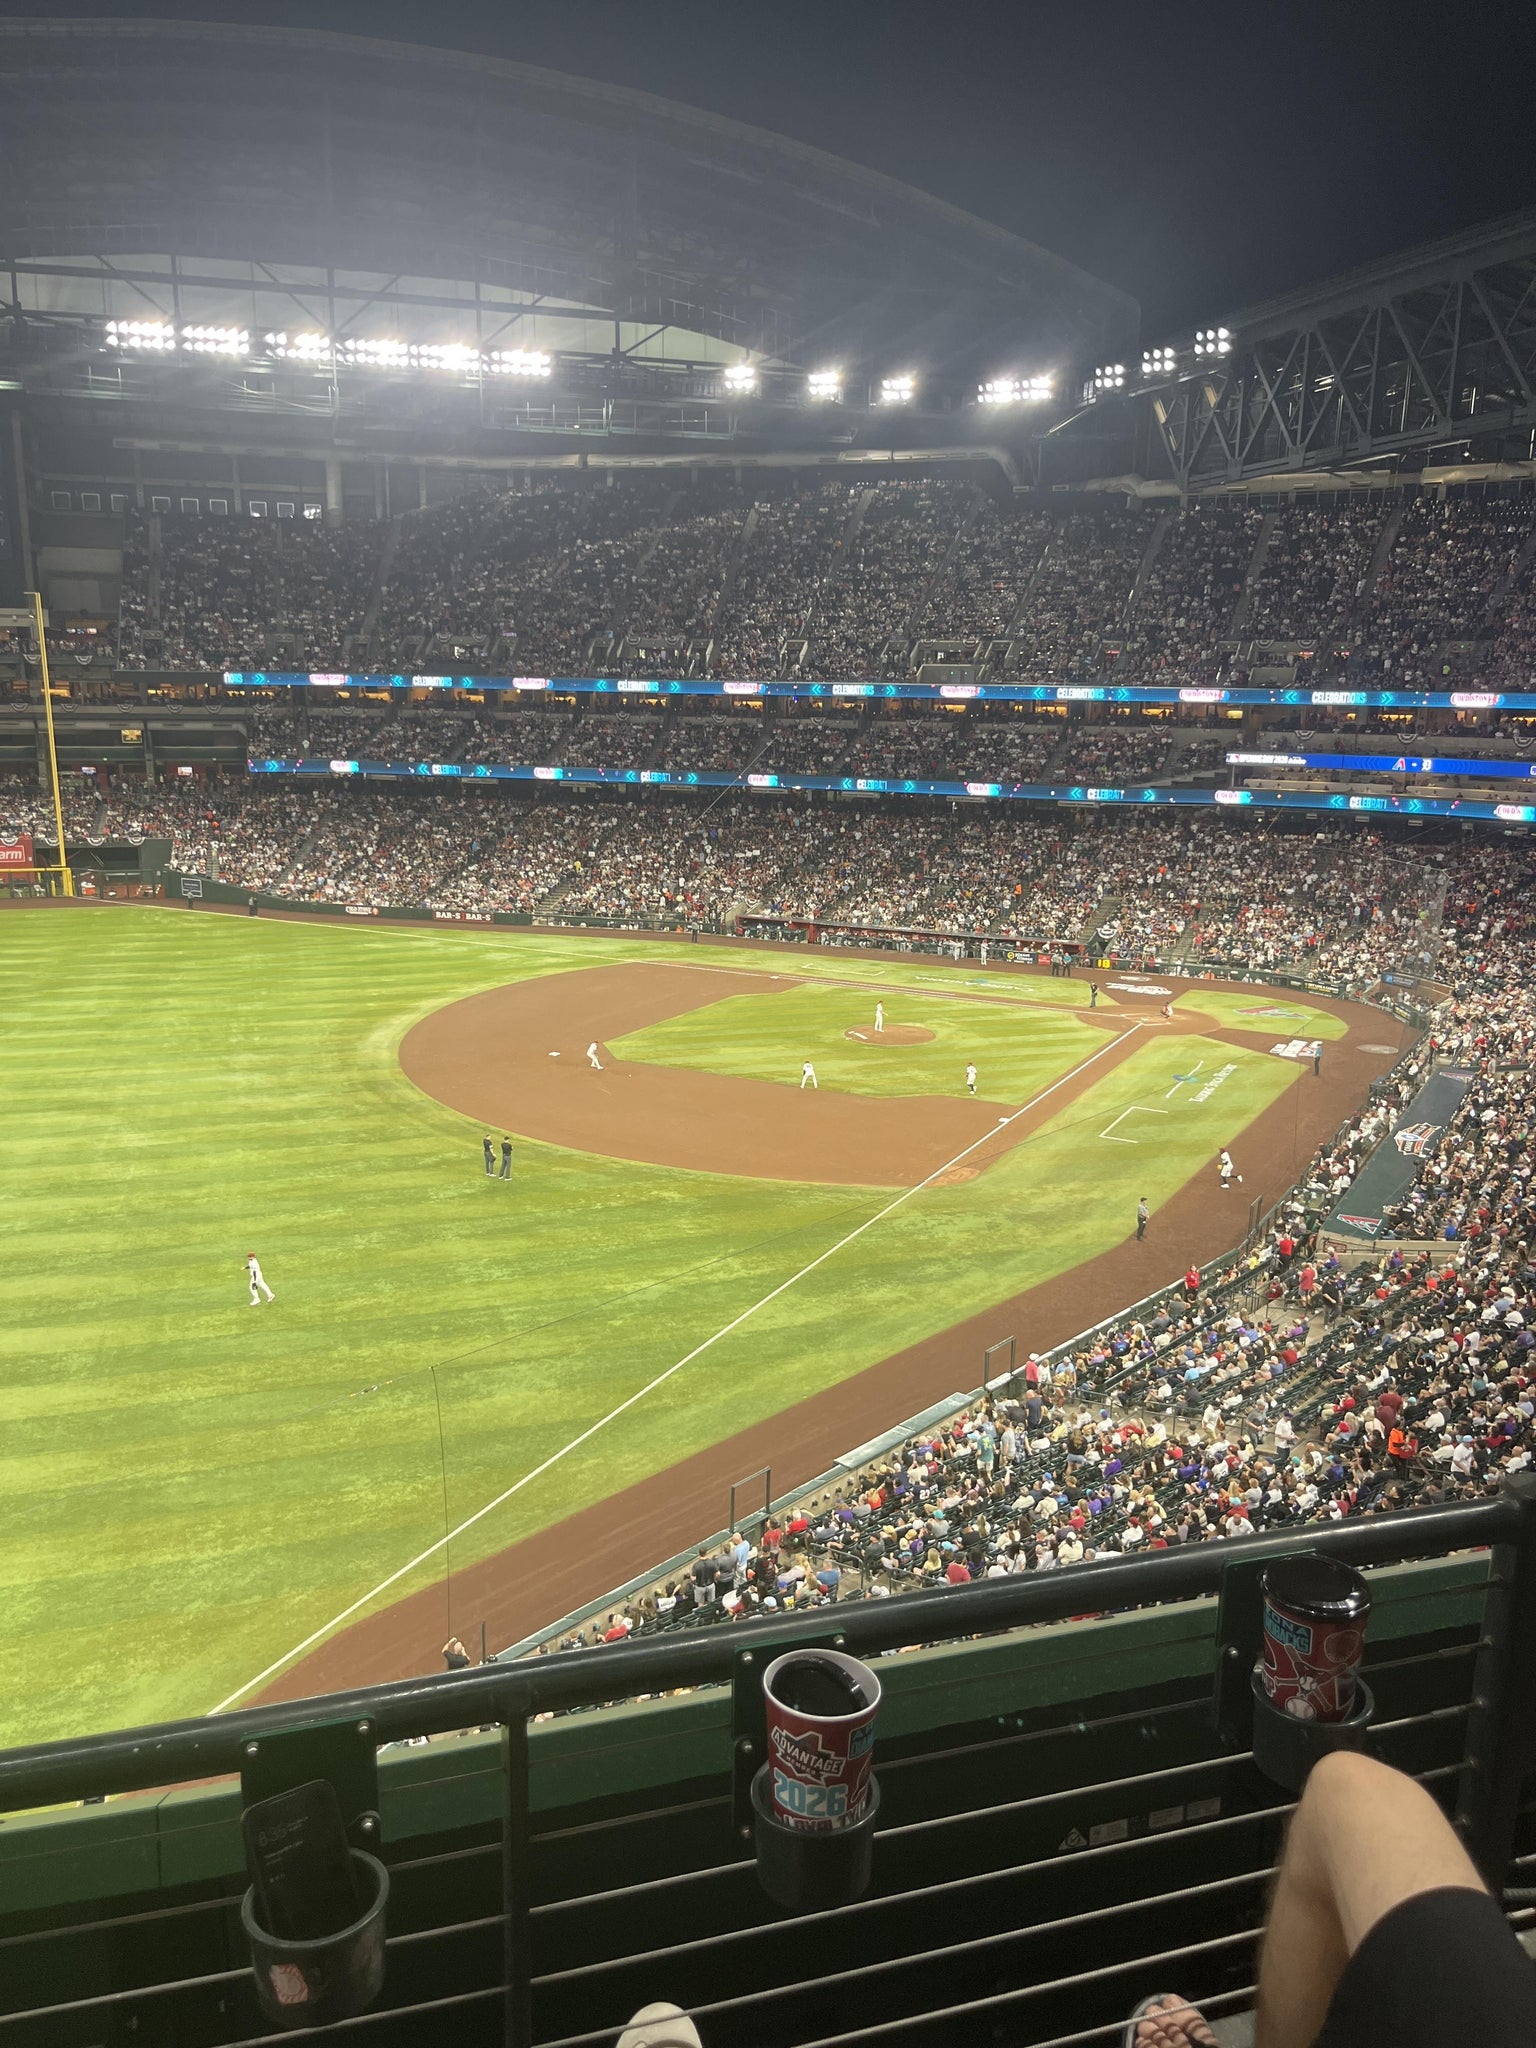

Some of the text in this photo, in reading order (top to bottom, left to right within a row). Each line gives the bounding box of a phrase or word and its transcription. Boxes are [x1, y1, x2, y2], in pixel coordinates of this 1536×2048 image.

[1056, 688, 1104, 699] CELEBRATIONS
[1311, 692, 1366, 705] CELEBRATIONS
[435, 911, 491, 921] BAR-S BAR-S
[773, 1733, 841, 1773] ADVANTAGE
[785, 1755, 817, 1776] MEMBER
[774, 1768, 849, 1818] 2026
